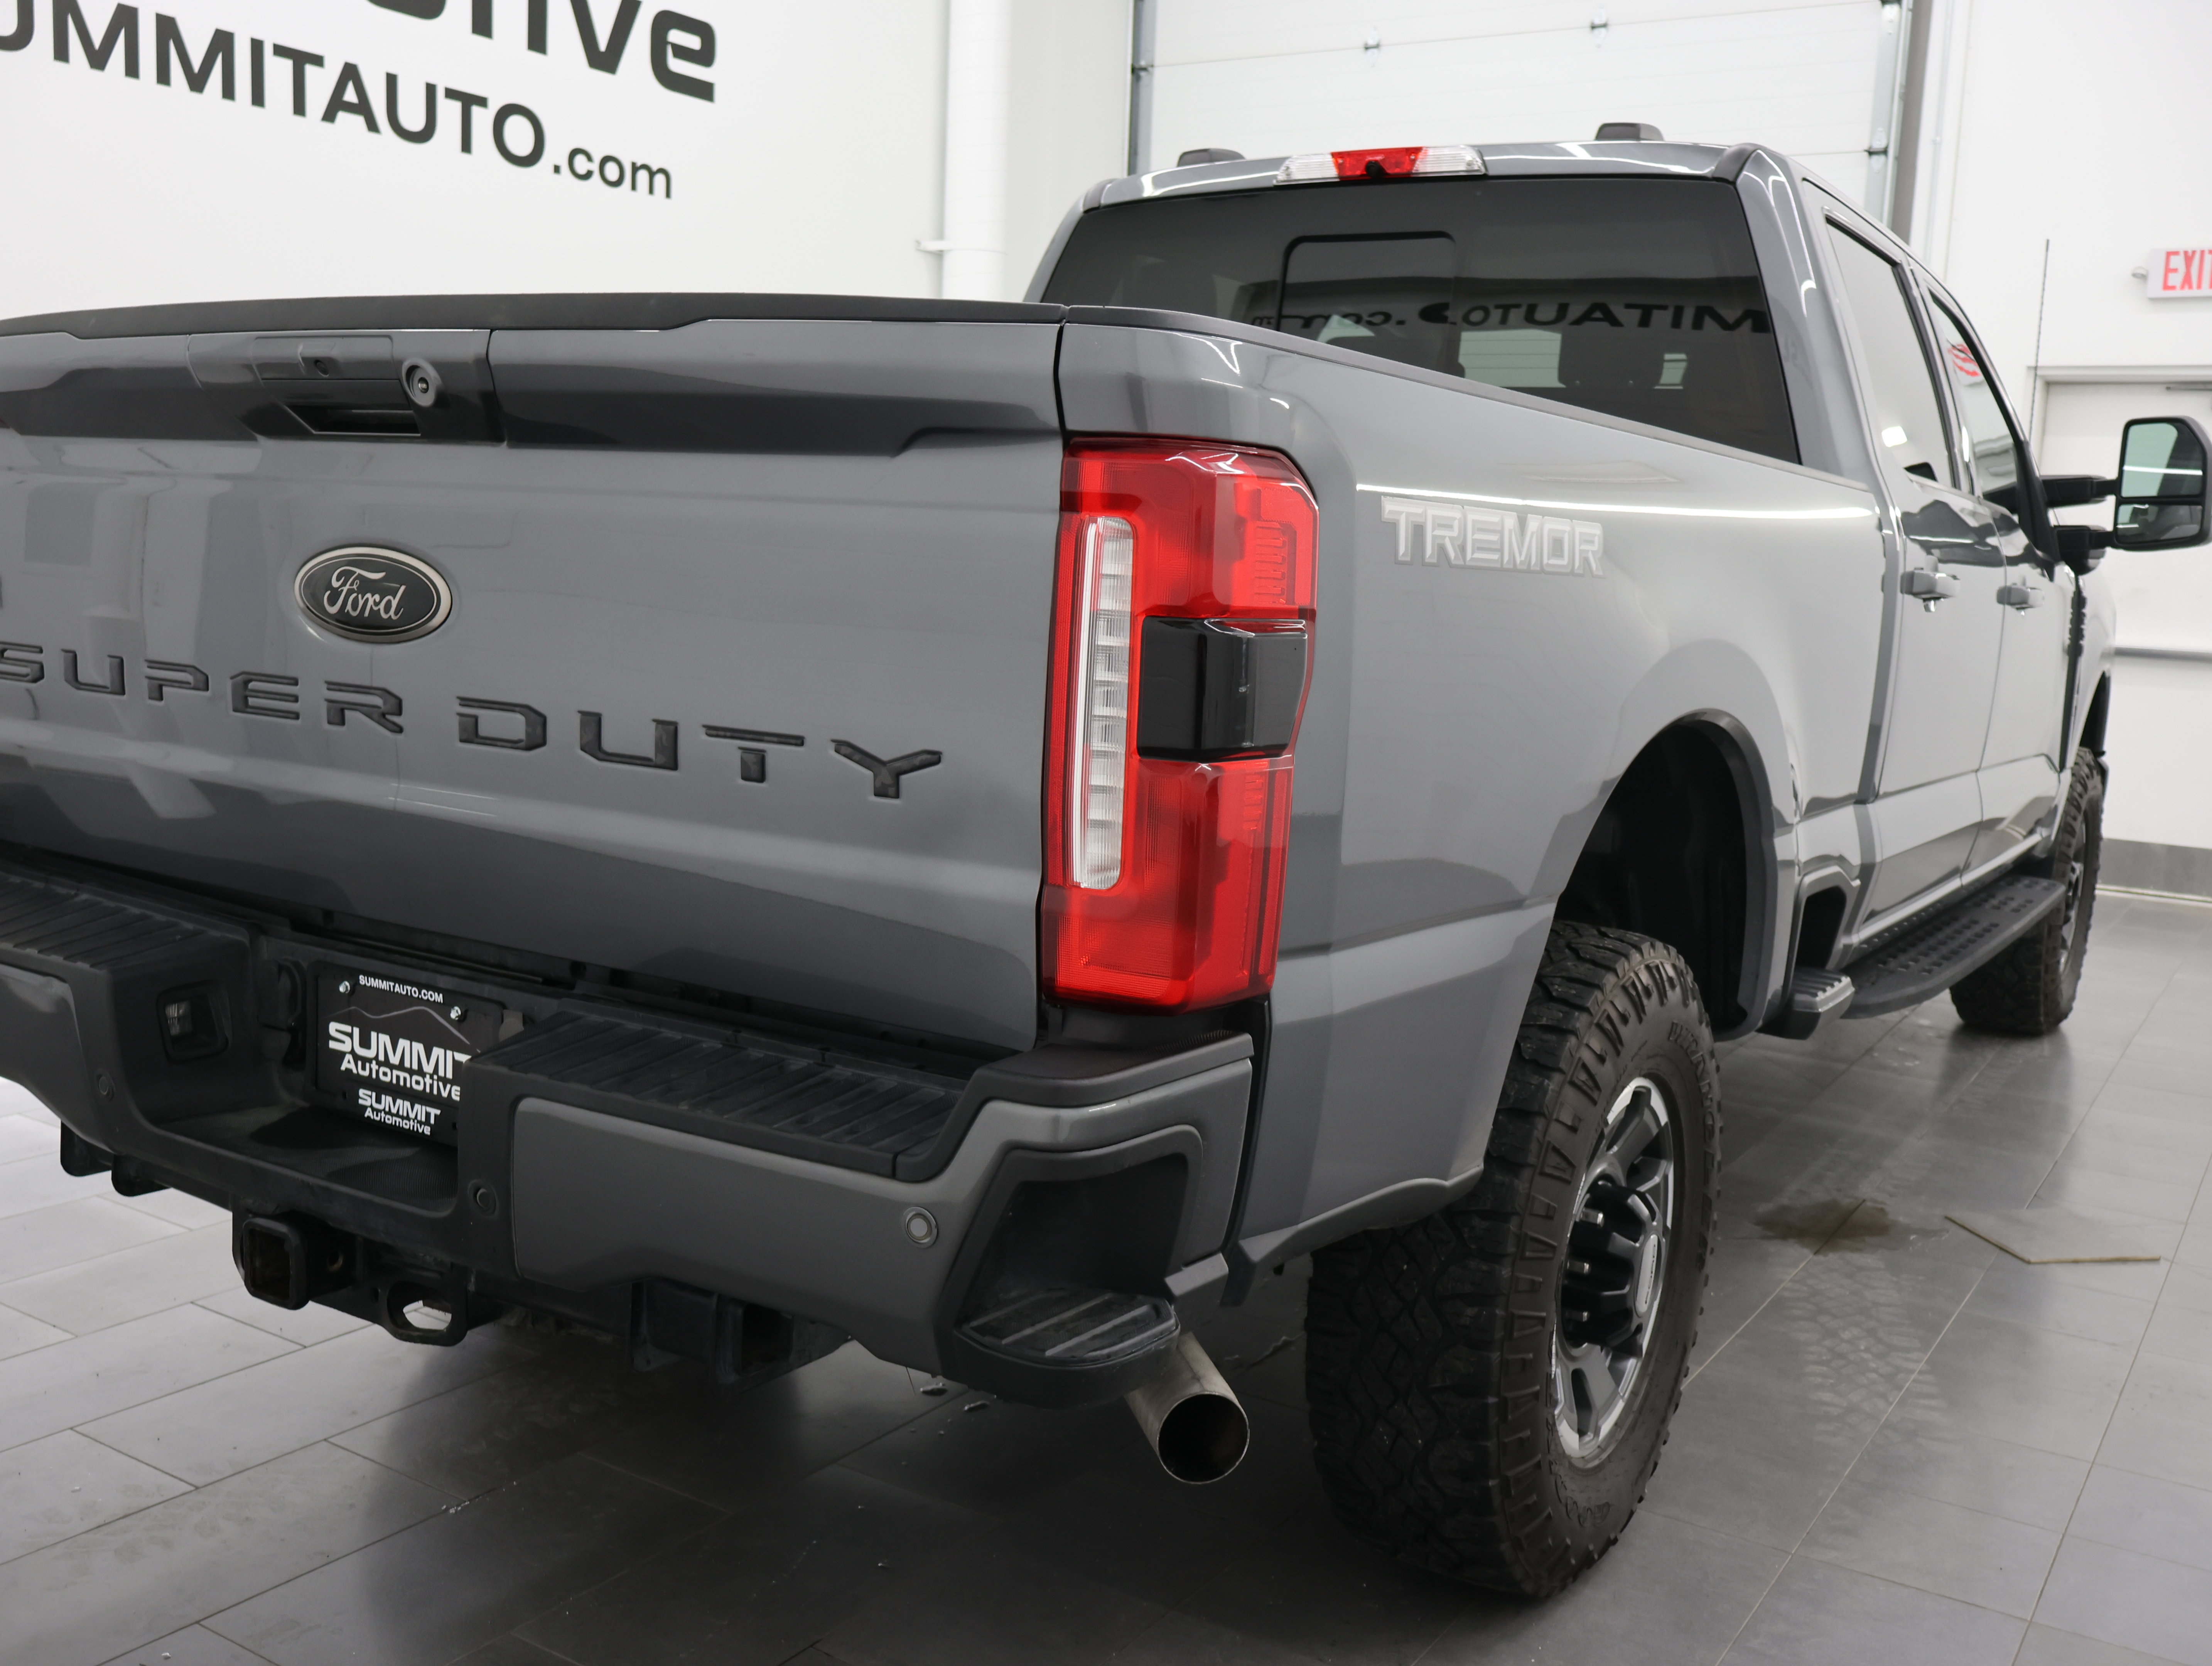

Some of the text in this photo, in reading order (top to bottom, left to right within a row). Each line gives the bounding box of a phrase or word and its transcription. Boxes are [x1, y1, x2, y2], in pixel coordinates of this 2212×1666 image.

[1382, 496, 1605, 578] TREMOR
[323, 566, 406, 620] Ford
[0, 641, 943, 799] SUPER DUTY
[359, 974, 444, 1003] SUMMITAUTO.COM
[340, 1053, 461, 1101] Automotive
[358, 1088, 441, 1125] SUMMIT
[364, 1107, 431, 1136] Automotive
